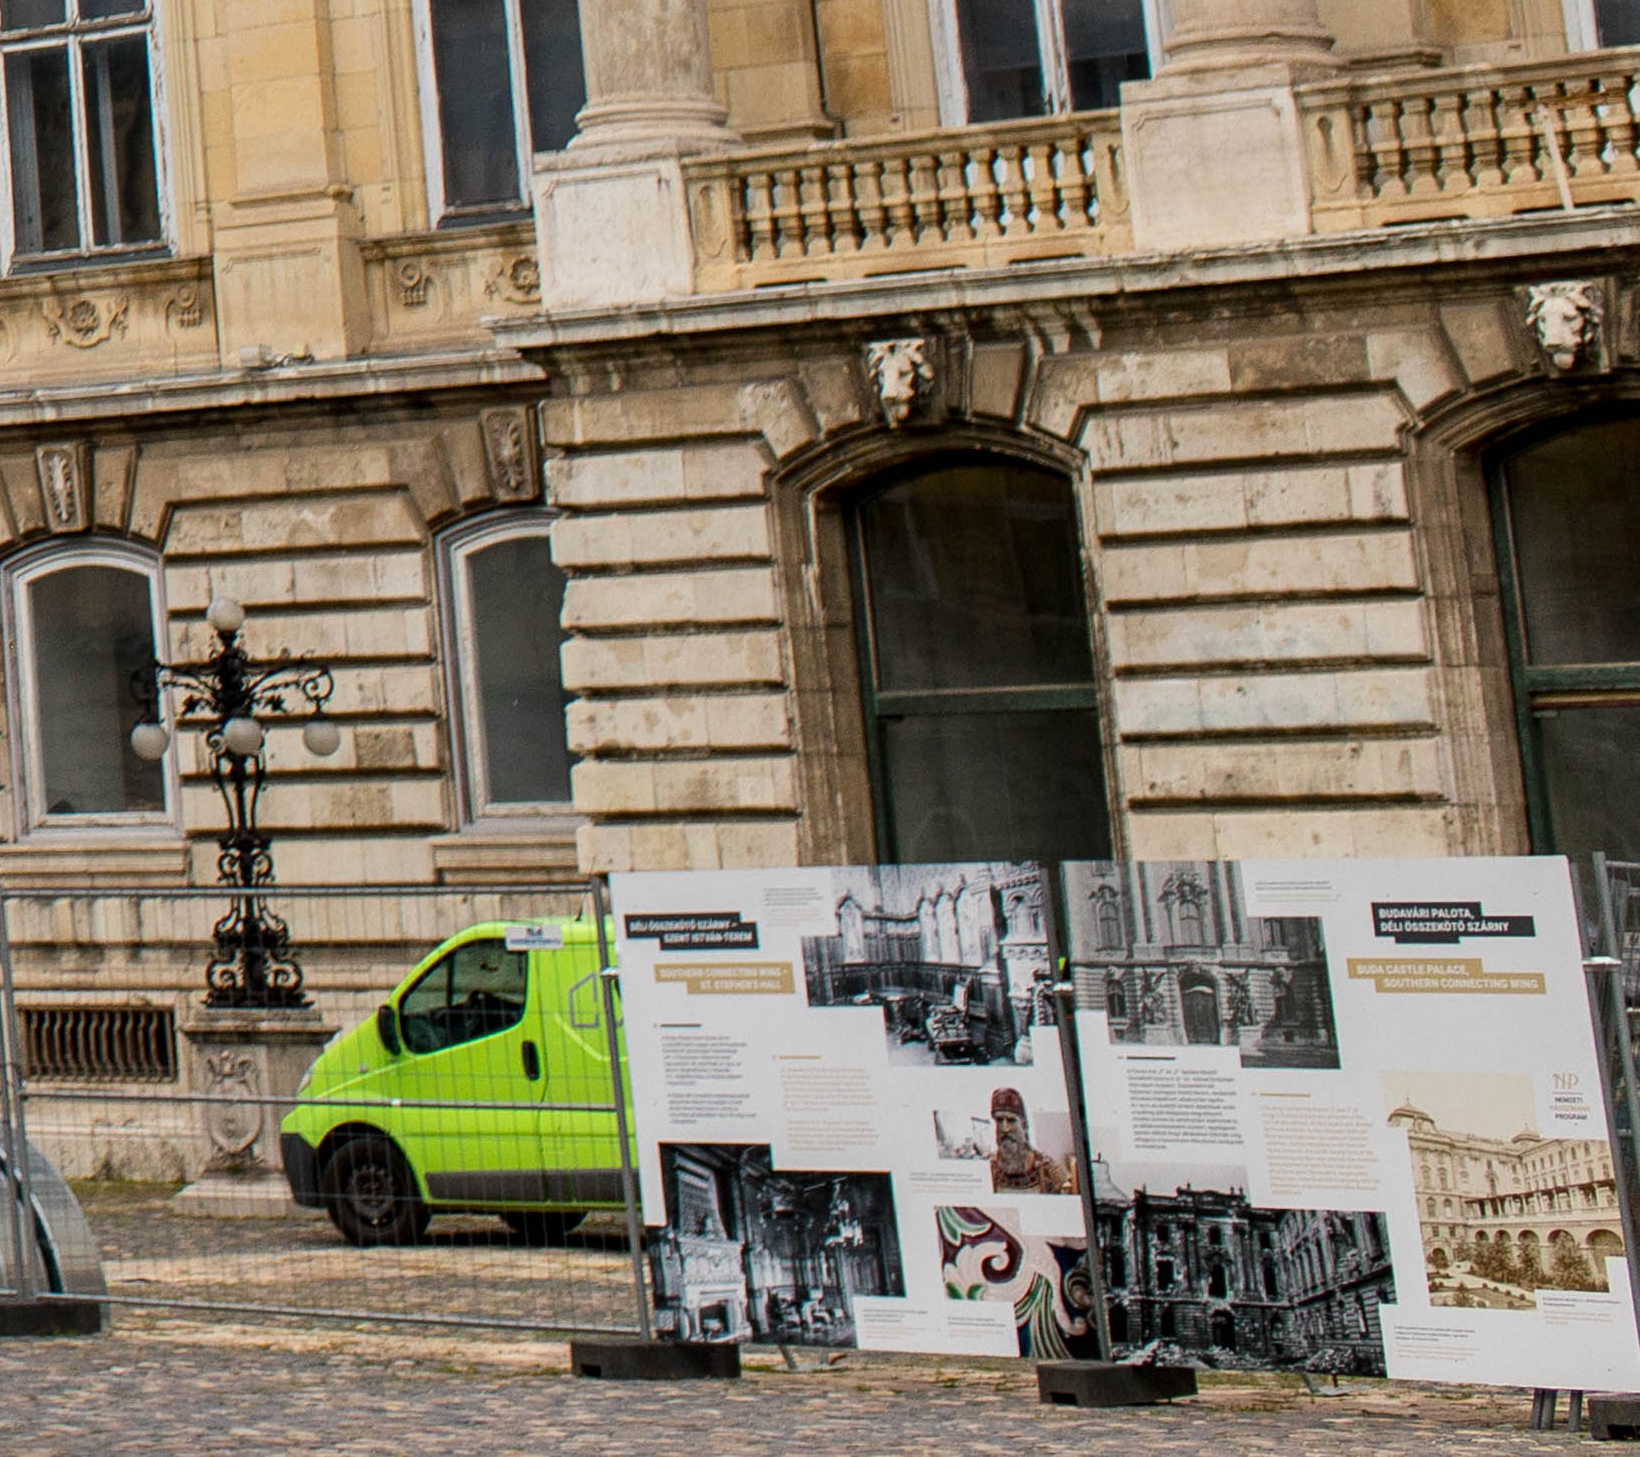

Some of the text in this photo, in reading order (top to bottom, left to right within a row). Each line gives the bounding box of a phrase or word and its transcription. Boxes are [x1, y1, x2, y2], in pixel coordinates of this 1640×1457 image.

[1378, 906, 1475, 920] BUDAVÁRI PALOTA,
[1380, 920, 1509, 933] DÉLI ÖSSZEKÖTŐ SZÁRNY
[1356, 964, 1470, 976] BUDA CASTLE PALACE,
[1383, 978, 1539, 990] SOUTHERN CONNECTING WING
